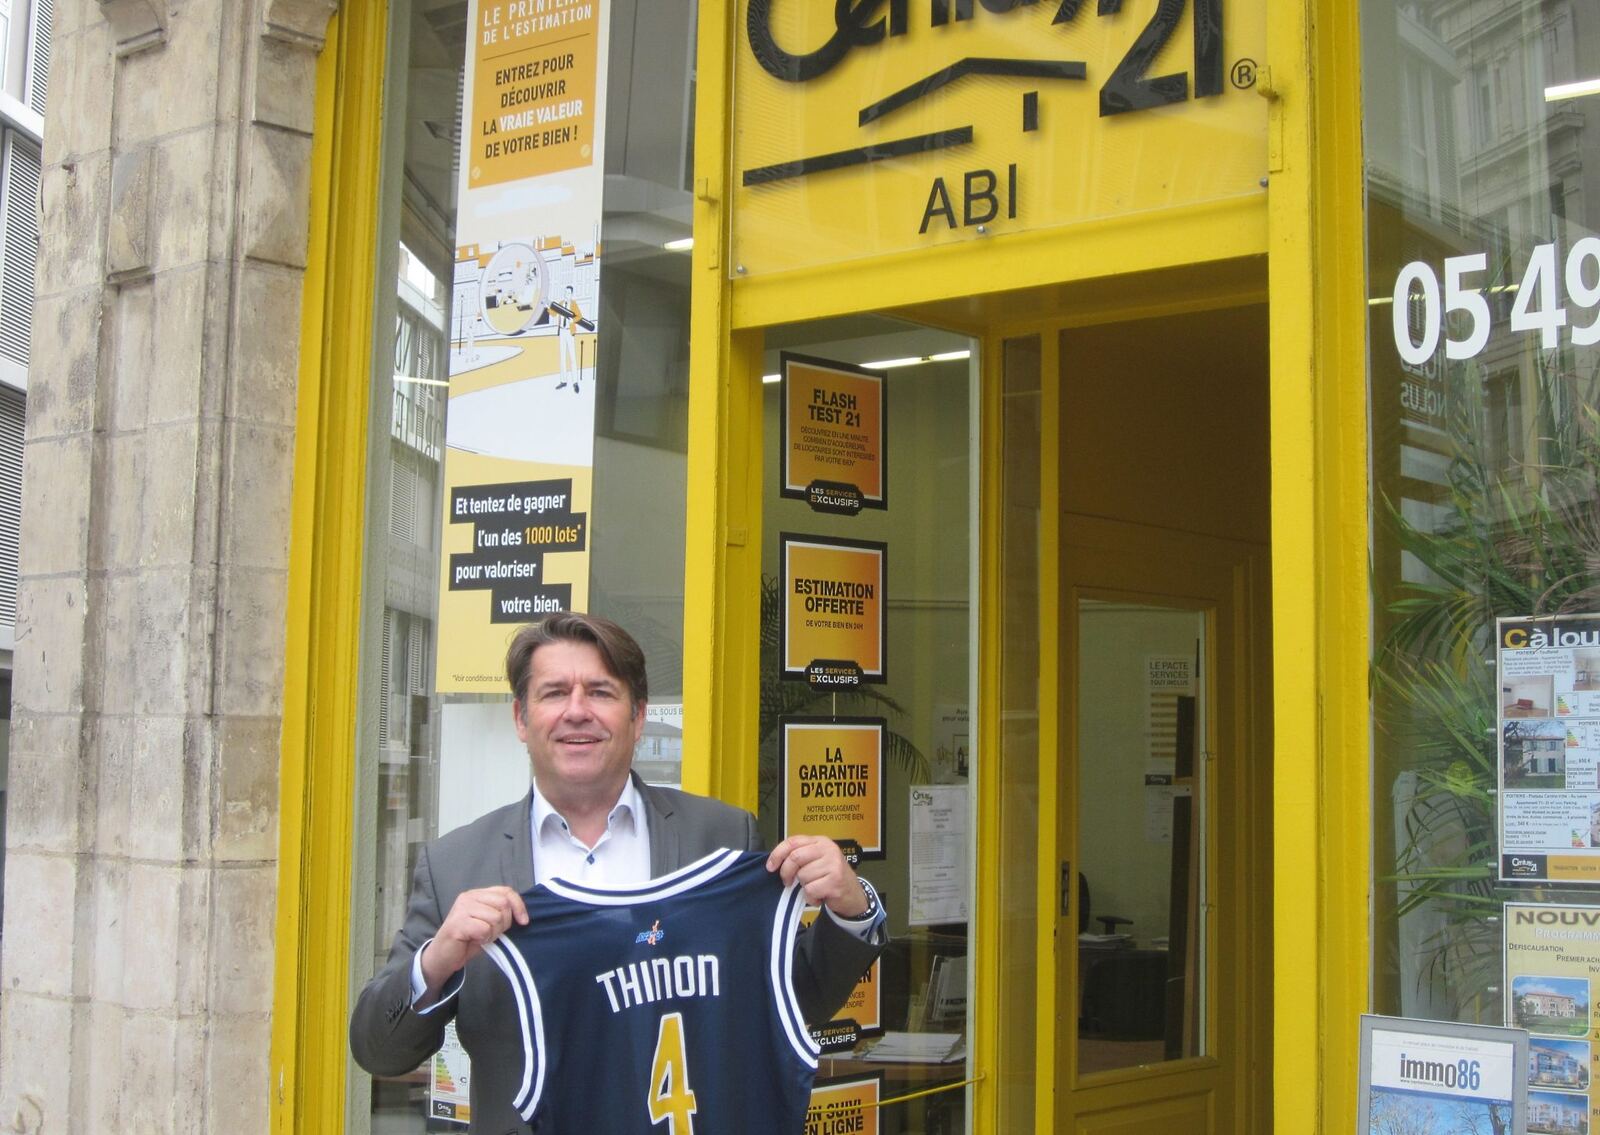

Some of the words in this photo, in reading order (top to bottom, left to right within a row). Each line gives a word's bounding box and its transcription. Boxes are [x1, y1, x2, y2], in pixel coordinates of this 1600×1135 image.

[484, 7, 501, 27] LE
[509, 0, 580, 20] PRINT
[483, 28, 498, 45] DE
[503, 4, 592, 40] L'ESTIMATION
[495, 60, 540, 86] ENTREZ
[542, 53, 574, 75] POUR
[501, 79, 566, 109] DÉCOUVRIR
[483, 120, 497, 136] LA
[500, 108, 535, 132] VRAIE
[536, 100, 583, 123] VALEUR
[485, 141, 500, 159] DE
[503, 133, 539, 155] VOTRE
[542, 126, 570, 146] BIEN
[918, 163, 1017, 235] ABI
[1393, 253, 1491, 365] 05
[1510, 237, 1600, 350] 49
[813, 388, 857, 410] FLASH
[808, 404, 842, 424] TEST
[845, 411, 861, 427] 21
[811, 487, 824, 495] LES
[825, 489, 857, 498] SERVICES
[811, 494, 860, 508] EXCLUSIFS
[455, 497, 468, 515] Et
[470, 496, 505, 514] tentez
[507, 494, 522, 511] de
[524, 493, 566, 514] gagner
[478, 529, 499, 548] l'un
[501, 528, 522, 547] des
[524, 526, 552, 544] 1000
[455, 564, 483, 583] pour
[484, 560, 536, 579] valoriser
[795, 578, 874, 599] ESTIMATION
[501, 597, 532, 614] votre
[534, 595, 563, 613] bien.
[805, 596, 864, 615] OFFERTE
[806, 619, 813, 627] DE
[814, 620, 832, 628] VOTRE
[832, 621, 845, 629] BIEN
[845, 622, 853, 630] EN
[1150, 661, 1161, 670] LE
[1162, 661, 1189, 670] PACTE
[1150, 671, 1189, 679] SERVICES
[465, 674, 493, 682] conditions
[810, 674, 859, 684] EXCLUSIFS
[825, 747, 843, 763] LA
[799, 764, 869, 781] GARANTIE
[801, 781, 866, 798] D'ACTION
[806, 805, 824, 813] NOTRE
[819, 814, 834, 822] POUR
[834, 813, 851, 821] VOTRE
[851, 813, 864, 821] BIEN
[1516, 911, 1600, 926] NOUV
[1556, 954, 1585, 962] PREMIER
[595, 954, 720, 1013] THINON
[814, 1033, 857, 1046] XCLUSIFS
[823, 1026, 855, 1036] SERVICES
[647, 1012, 697, 1135] 4
[1400, 1053, 1480, 1091] immo86
[826, 1098, 861, 1119] SUIVI
[823, 1115, 863, 1135] LIGNE
